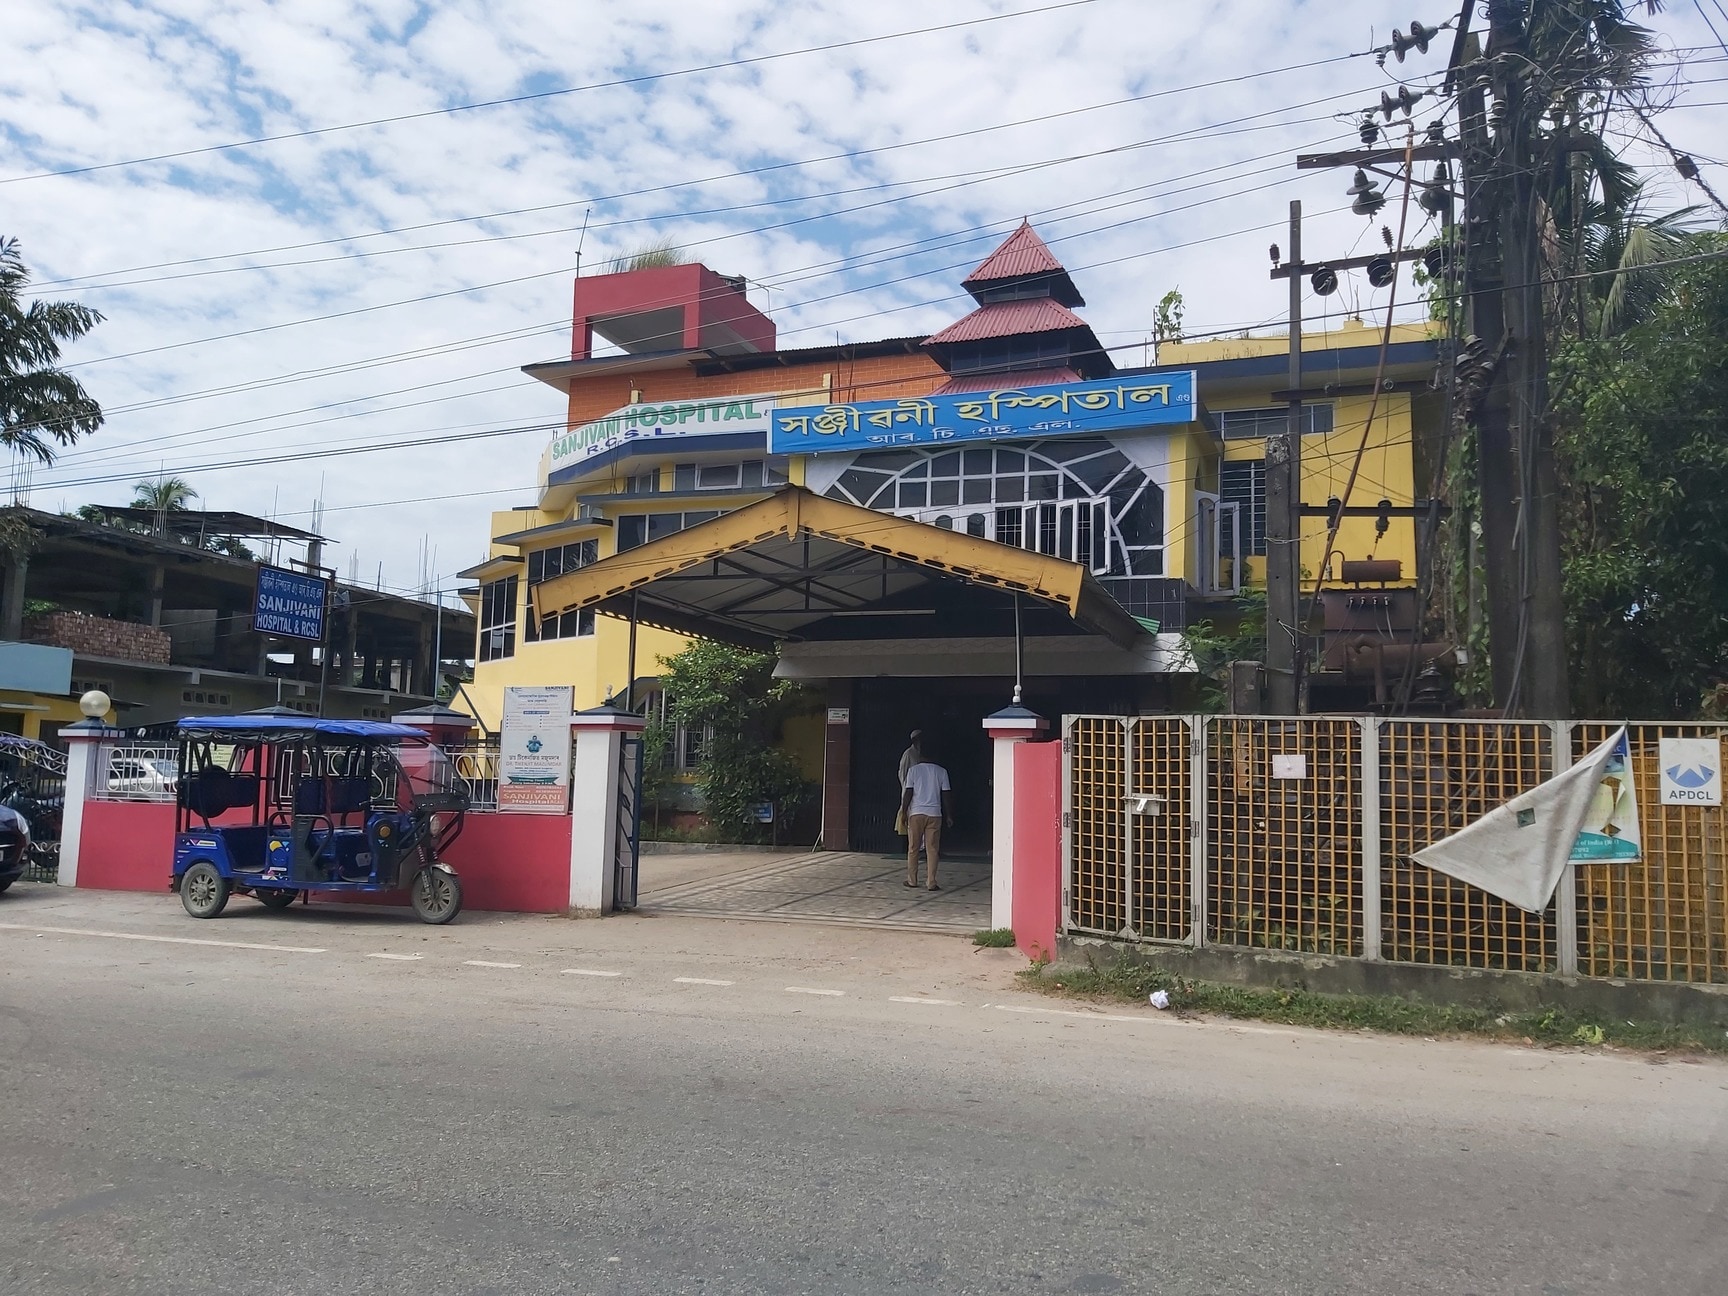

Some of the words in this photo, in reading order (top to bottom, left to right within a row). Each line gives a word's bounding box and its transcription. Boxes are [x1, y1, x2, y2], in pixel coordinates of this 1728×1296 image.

[552, 416, 621, 460] SANJIVANI
[625, 401, 762, 428] HOSPITAL
[259, 594, 320, 620] SANJIVANI
[257, 613, 292, 632] HOSPITAL
[294, 619, 300, 634] &
[301, 620, 319, 638] RCSL
[1669, 790, 1714, 801] APDCL
